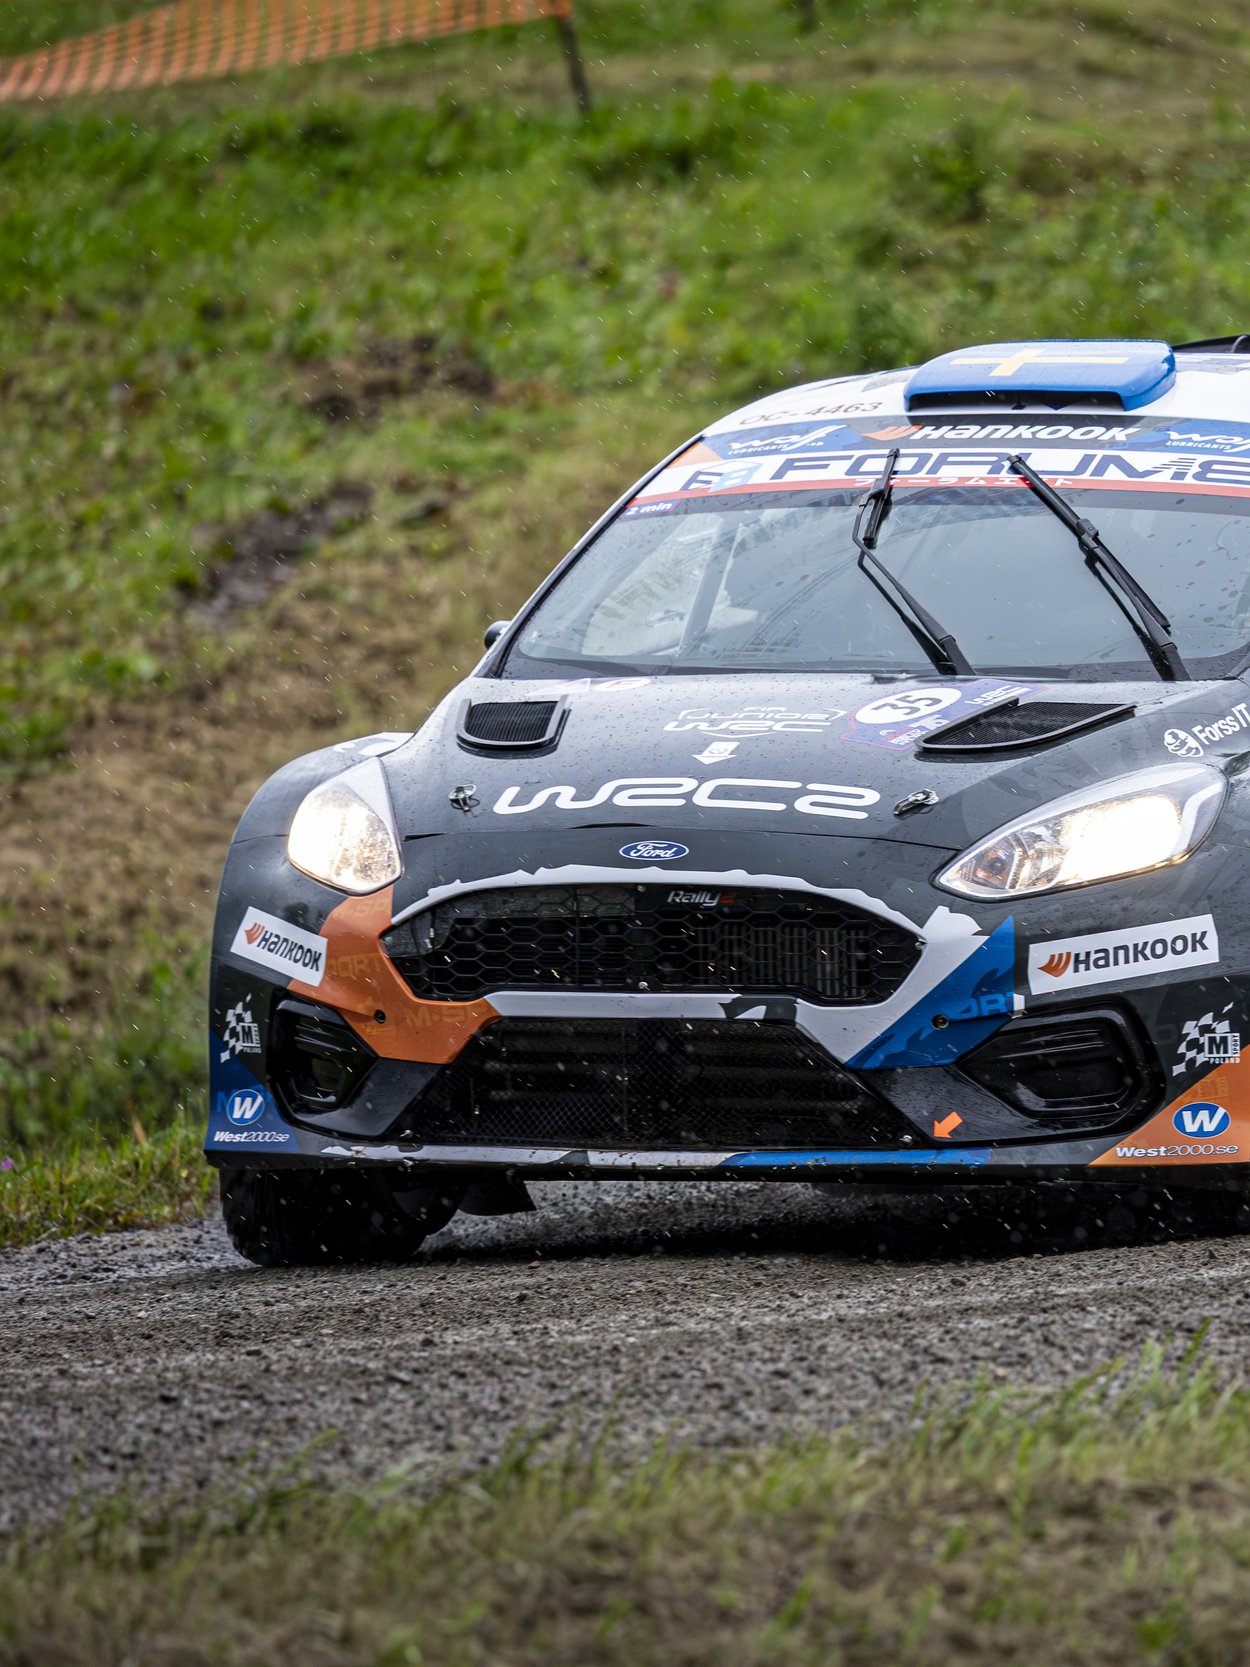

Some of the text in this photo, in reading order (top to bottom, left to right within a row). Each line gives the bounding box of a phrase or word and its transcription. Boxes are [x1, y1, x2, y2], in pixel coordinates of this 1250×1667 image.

[625, 500, 673, 516] 2 min
[871, 694, 944, 717] 35
[686, 711, 830, 720] JUNIOR
[663, 720, 832, 732] WRC
[1191, 714, 1241, 746] Forss
[629, 841, 679, 859] Ford
[1207, 1035, 1230, 1055] M
[232, 1095, 264, 1119] W
[1181, 1106, 1226, 1133] W
[1116, 1144, 1239, 1158] West2000.se
